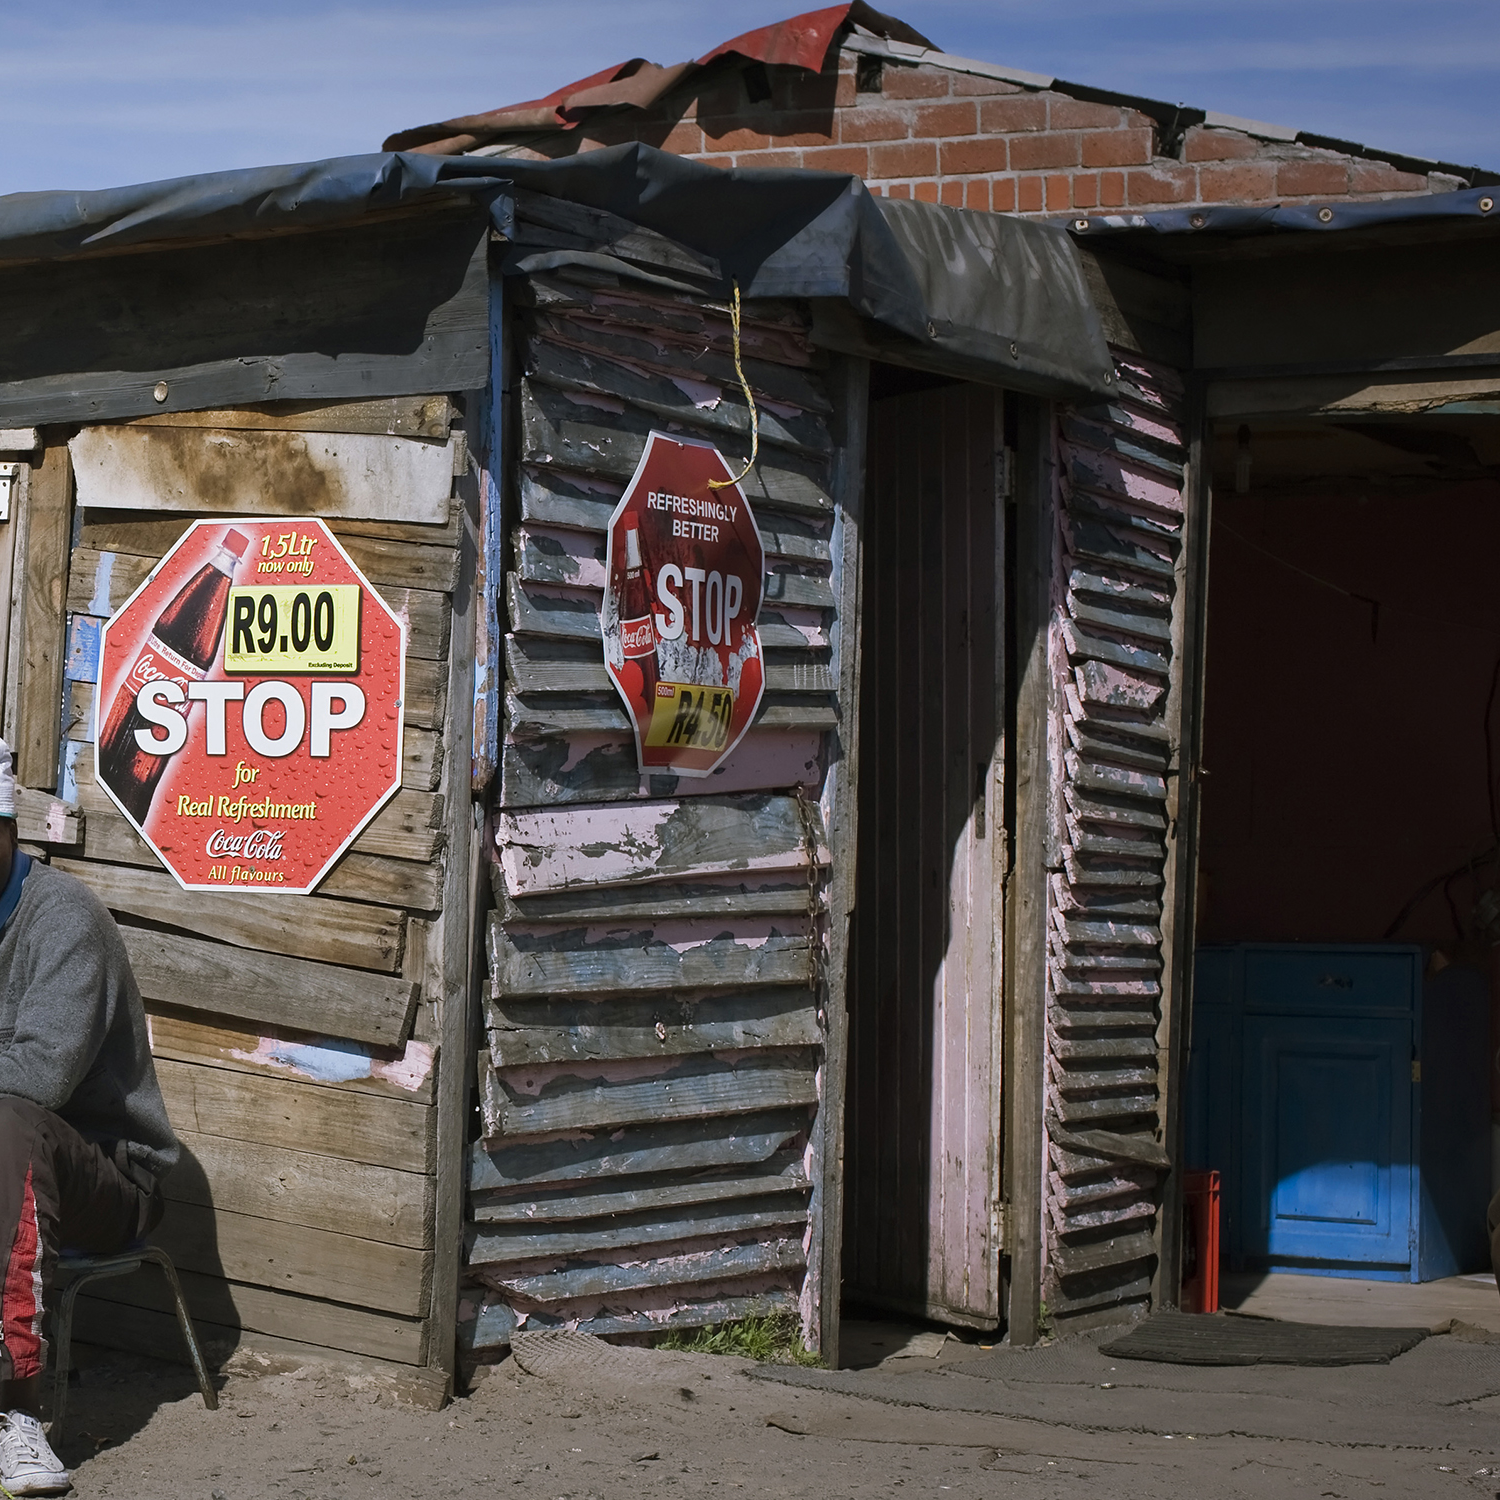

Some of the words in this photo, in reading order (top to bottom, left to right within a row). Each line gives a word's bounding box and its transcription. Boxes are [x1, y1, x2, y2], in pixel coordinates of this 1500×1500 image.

[647, 491, 738, 523] REFRESHINGLY
[261, 531, 318, 560] 1,5Ltr
[672, 519, 719, 543] BETTER
[257, 561, 285, 573] now
[286, 556, 315, 578] only
[655, 563, 744, 648] STOP
[231, 591, 335, 654] R9.00
[162, 647, 181, 665] Return
[181, 661, 192, 672] For
[657, 686, 674, 697] 500ml
[133, 680, 366, 757] STOP
[666, 690, 732, 748] R4.50
[232, 760, 260, 789] for
[177, 795, 214, 817] Real
[217, 795, 317, 824] Refreshment
[206, 829, 287, 860] Coca-Cola
[208, 865, 227, 880] All
[229, 865, 284, 884] flavours
